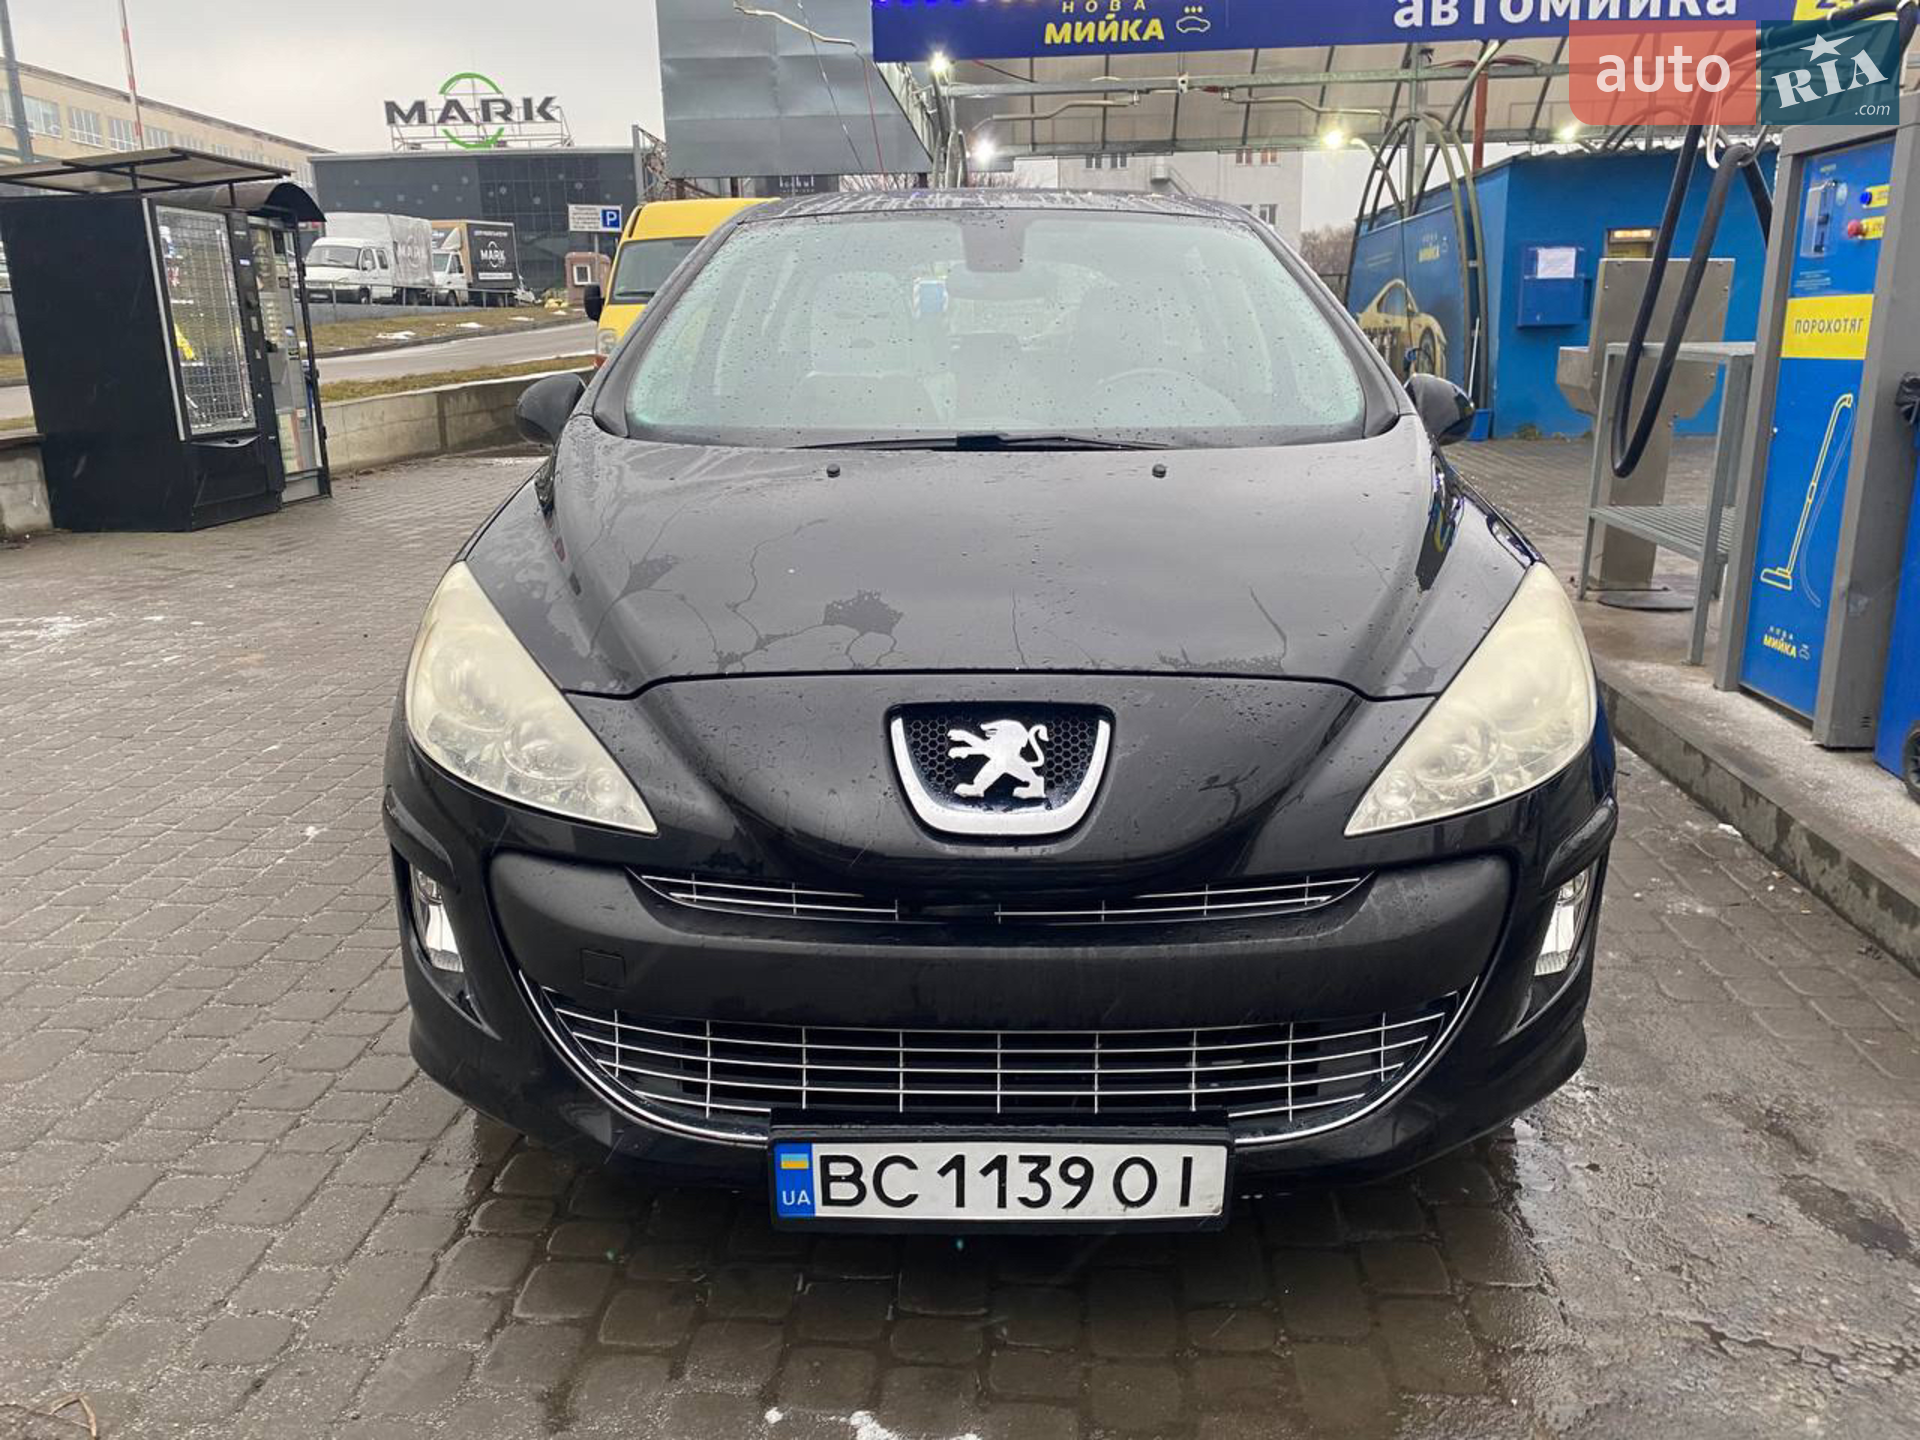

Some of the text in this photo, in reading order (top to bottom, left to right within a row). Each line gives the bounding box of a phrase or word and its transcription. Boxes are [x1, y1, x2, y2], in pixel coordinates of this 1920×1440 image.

[1062, 0, 1146, 13] НОВА
[1044, 13, 1165, 45] МИЙКА
[384, 96, 557, 125] MARK
[480, 249, 505, 261] MARK
[1795, 318, 1864, 334] ПОРОХОТЯГ
[1763, 634, 1797, 658] МИЙКА
[819, 1154, 919, 1209] BC
[936, 1154, 1095, 1209] 1139
[782, 1190, 811, 1206] UA
